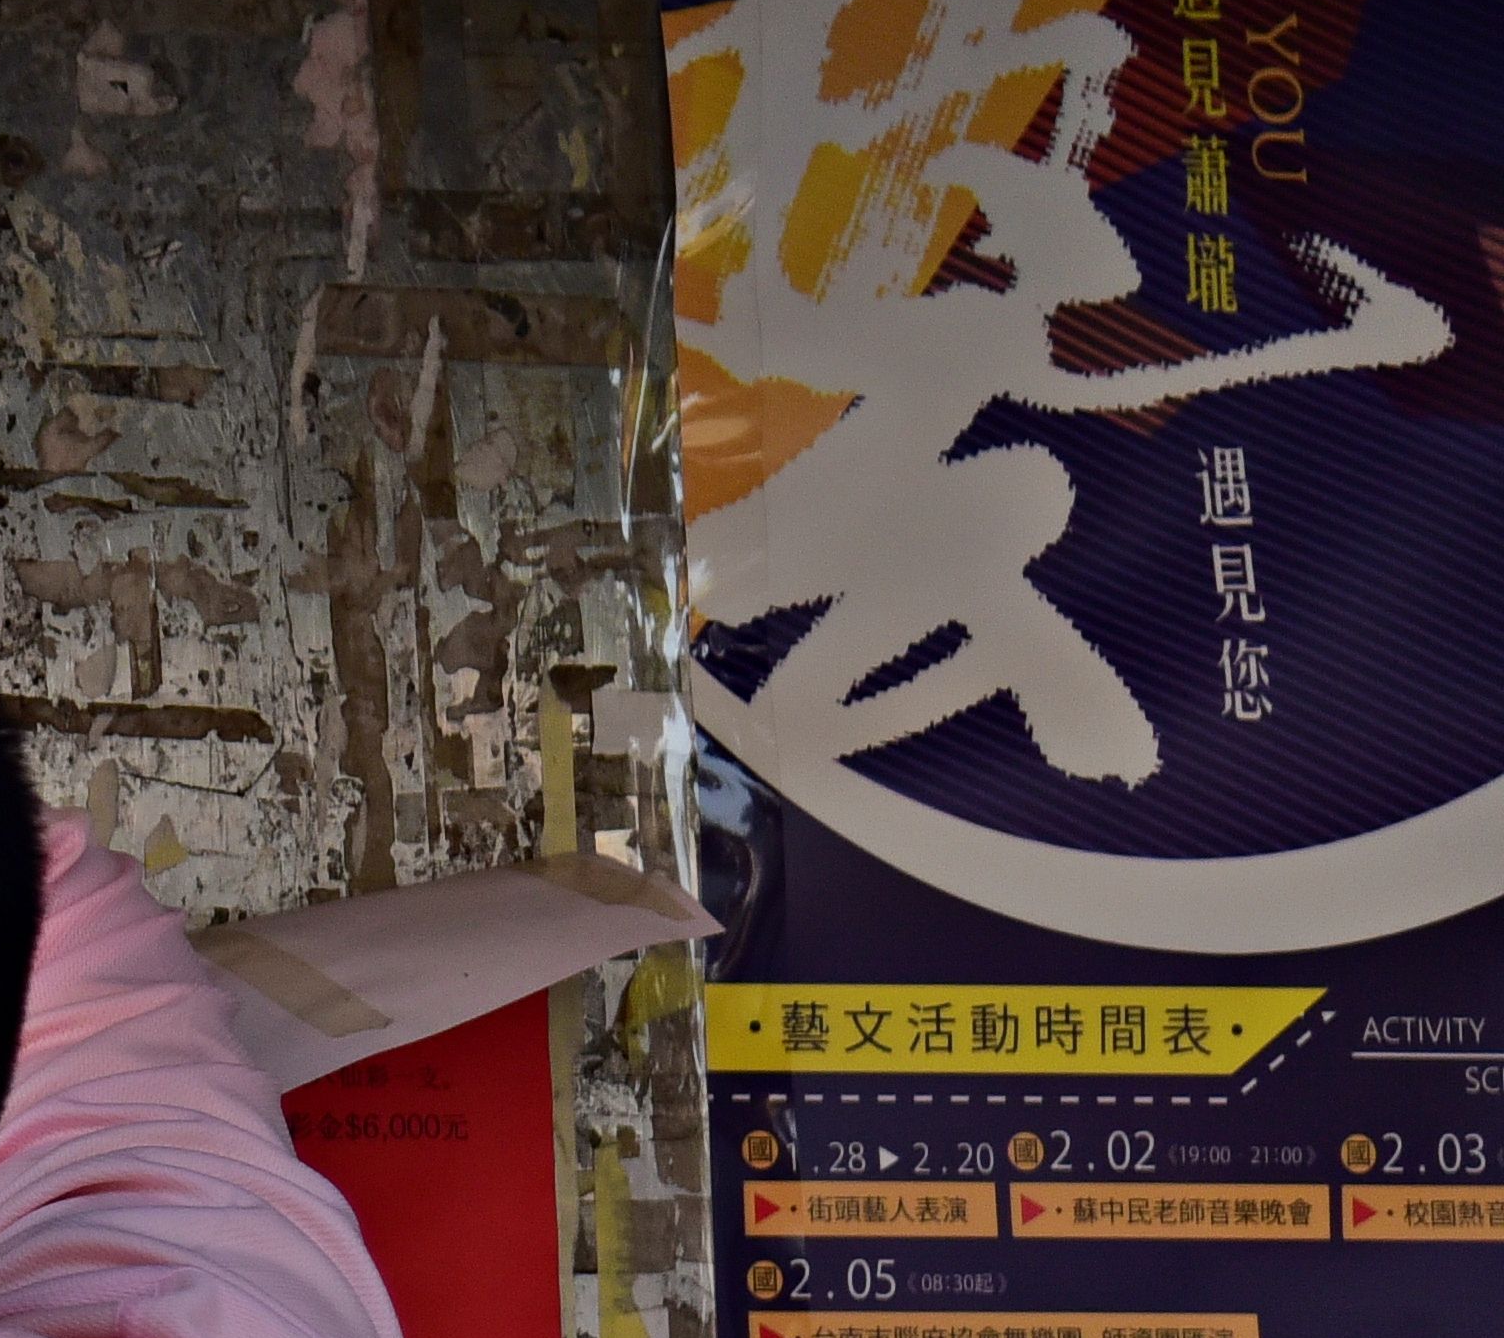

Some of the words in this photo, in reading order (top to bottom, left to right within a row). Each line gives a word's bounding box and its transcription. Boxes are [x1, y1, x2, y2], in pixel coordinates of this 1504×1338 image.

[1245, 14, 1308, 185] YOU
[1195, 445, 1274, 722] 遇見您
[780, 1000, 1214, 1057] 藝文活動時間表
[1362, 1016, 1486, 1045] ACTIVITY
[1464, 1065, 1504, 1094] SC
[807, 1196, 969, 1225] 街頭藝人表演
[1073, 1197, 1313, 1227] 蘇中民老師音樂晚會
